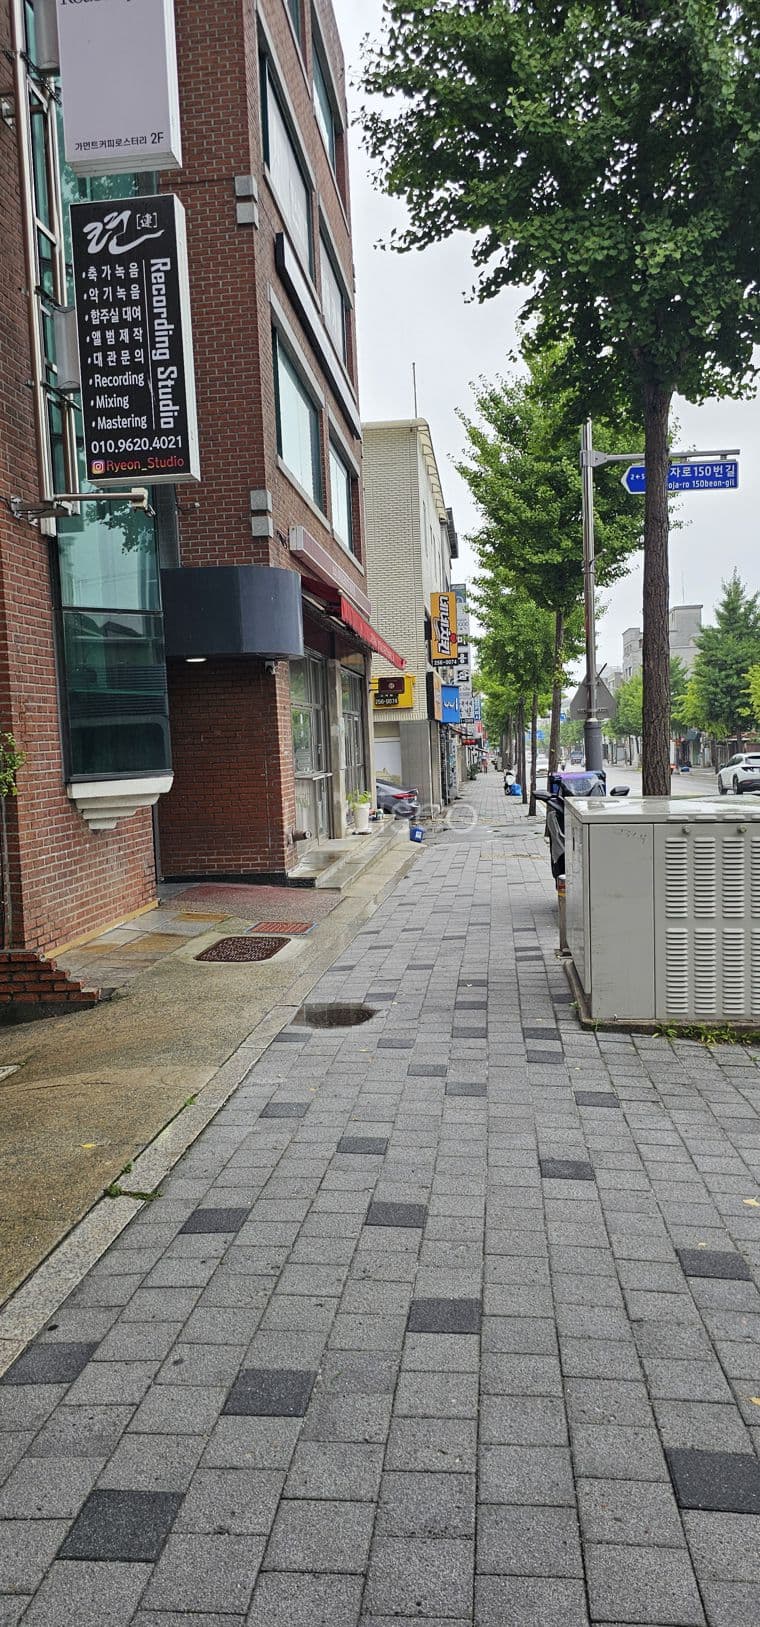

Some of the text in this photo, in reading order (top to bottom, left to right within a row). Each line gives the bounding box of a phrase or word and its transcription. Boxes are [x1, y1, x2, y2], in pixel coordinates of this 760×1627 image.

[74, 132, 164, 152] 가먼트커피로스터리 2F
[90, 306, 141, 325] 합주실 대여
[150, 257, 180, 429] Recording Studio
[94, 371, 145, 388] Recording
[96, 394, 130, 409] Mixing
[97, 413, 148, 430] Mastering
[91, 435, 182, 454] 010.9620.4021
[106, 455, 185, 473] Ryeon_Studio
[692, 478, 735, 489] 150beon-gil
[438, 594, 451, 656] 네네치킨
